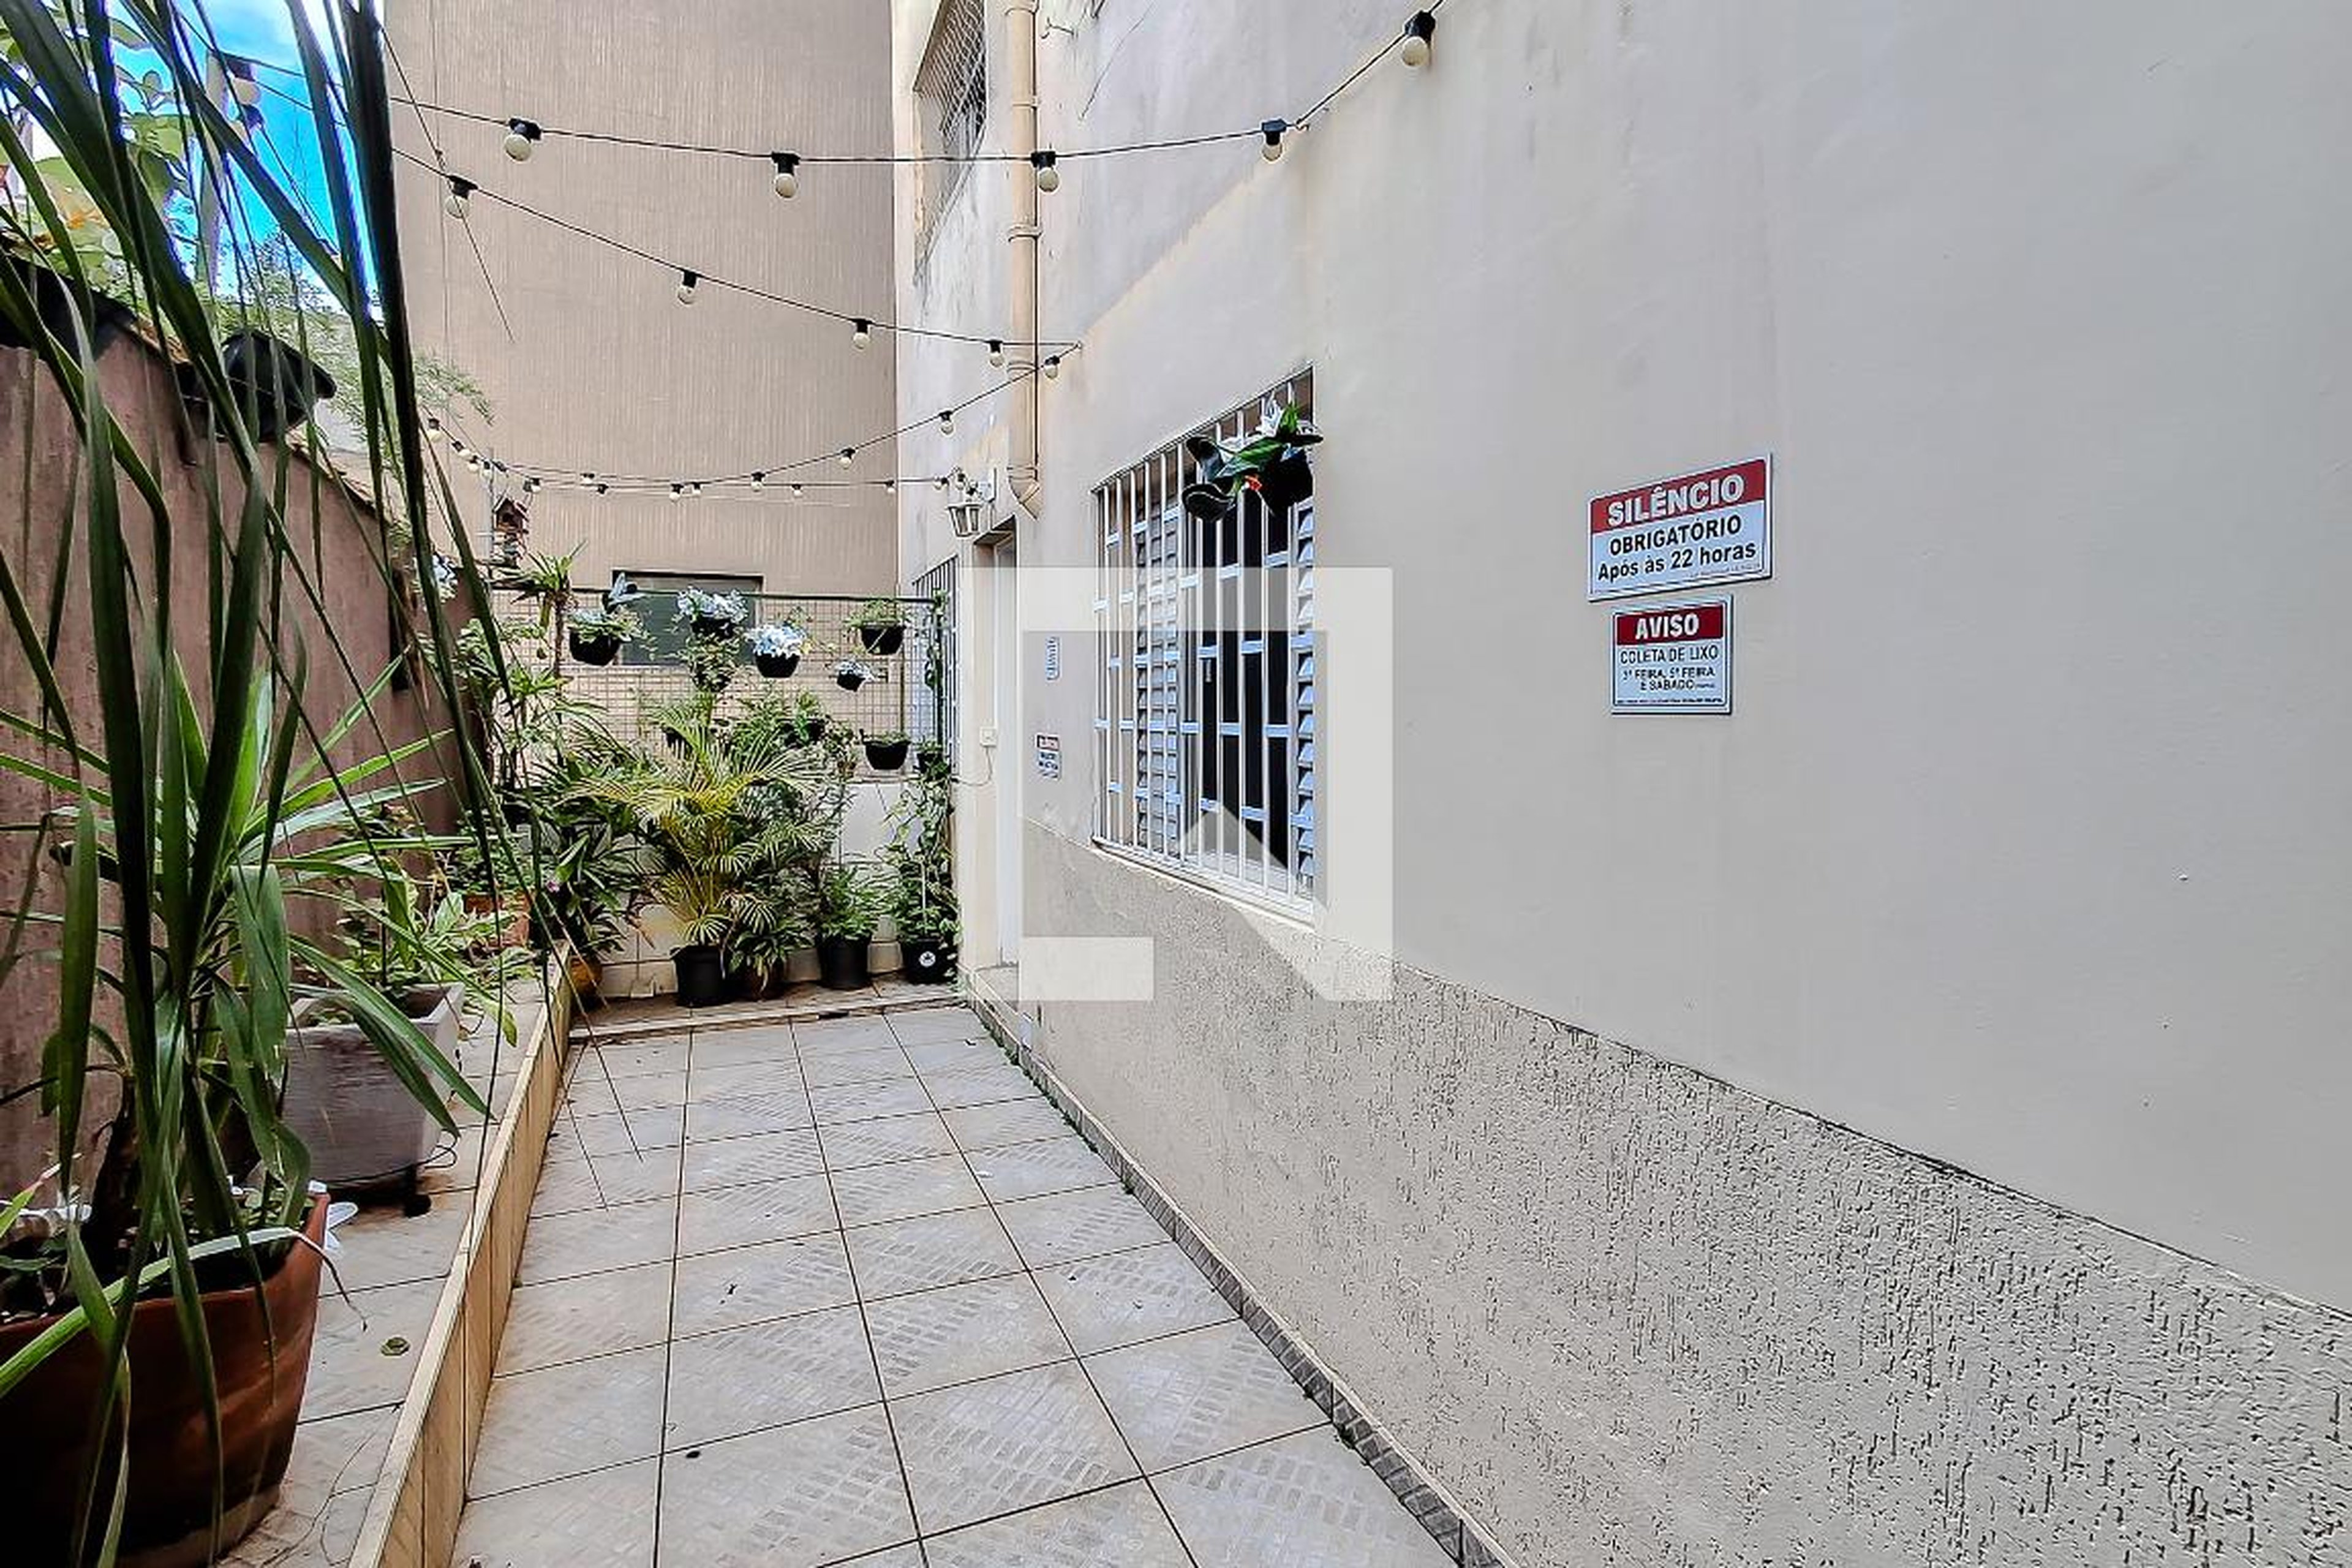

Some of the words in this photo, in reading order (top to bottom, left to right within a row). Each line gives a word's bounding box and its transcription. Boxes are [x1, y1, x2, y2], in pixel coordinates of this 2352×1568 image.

[1608, 474, 1744, 527] SILÊNCIO
[1610, 514, 1741, 556] OBRIGATÓRIO
[1598, 560, 1638, 582] Após
[1645, 555, 1664, 573] às
[1671, 549, 1692, 569] 22
[1700, 543, 1755, 565] horas
[1635, 613, 1700, 639] AVISO
[1621, 649, 1666, 664] COLETA
[1669, 647, 1684, 662] DE
[1690, 645, 1718, 660] LIXO
[1682, 666, 1716, 678] FEIRA
